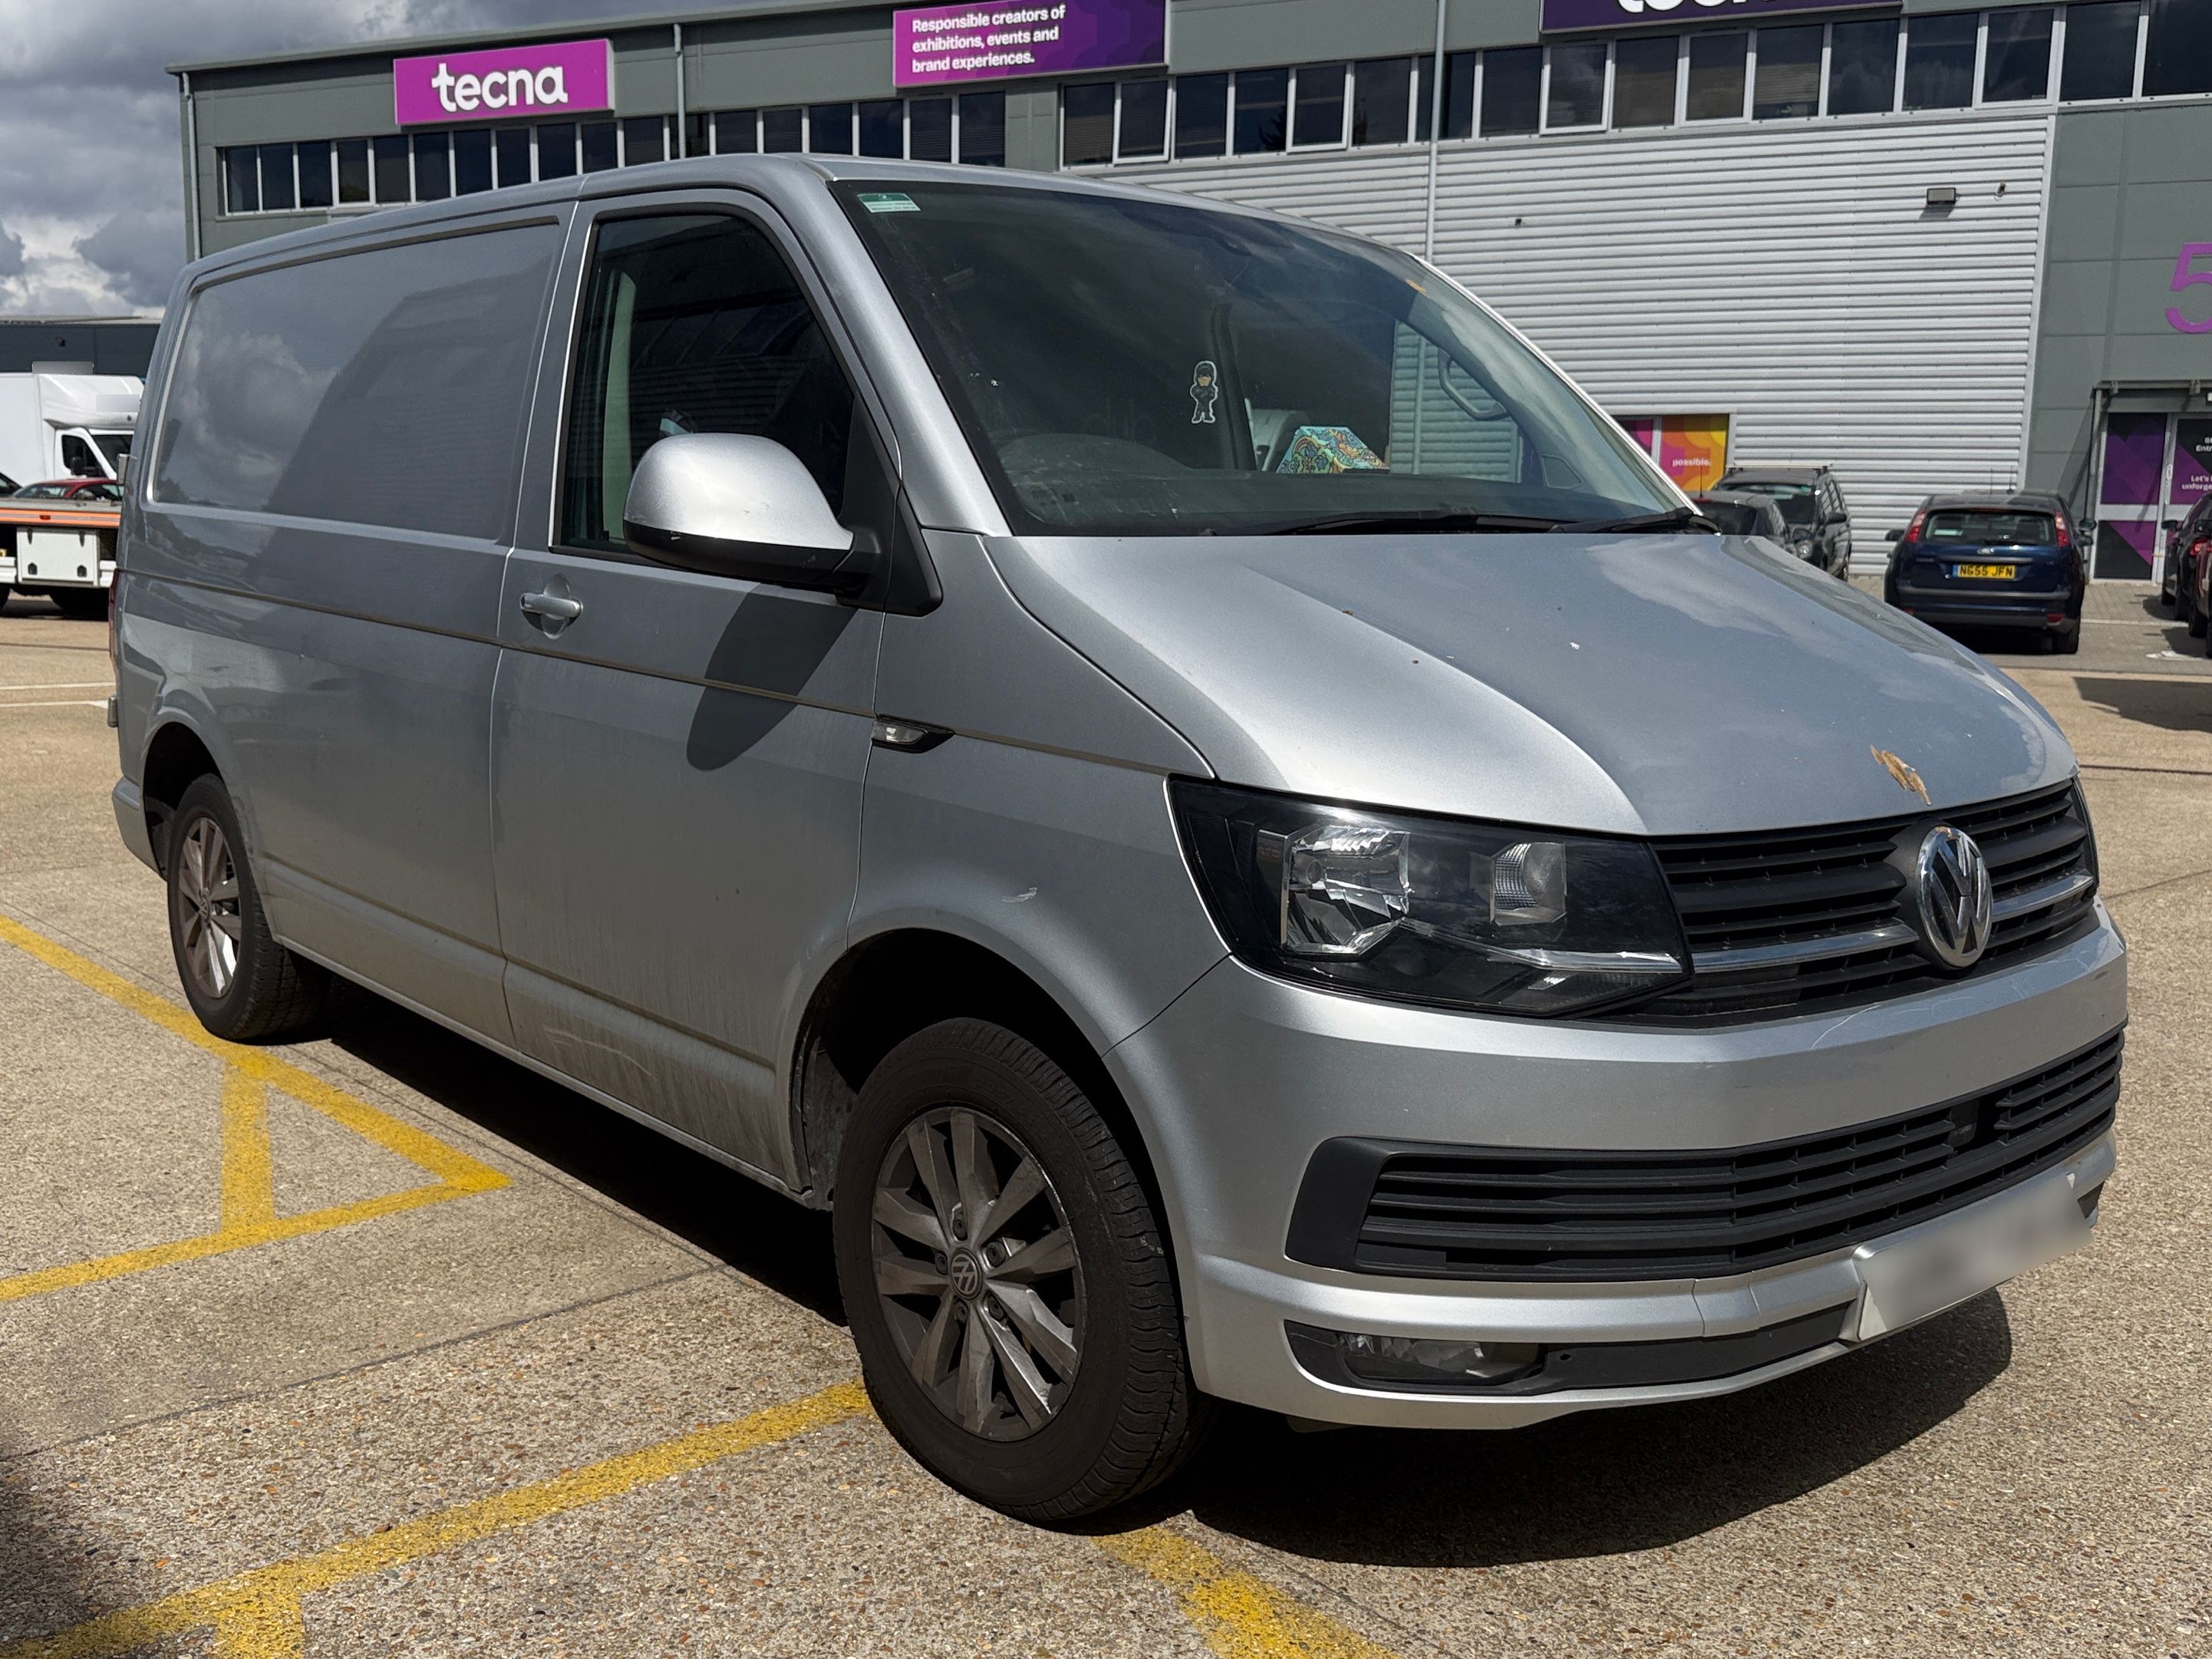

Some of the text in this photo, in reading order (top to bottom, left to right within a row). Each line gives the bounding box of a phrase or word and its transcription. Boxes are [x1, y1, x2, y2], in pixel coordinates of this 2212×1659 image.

[912, 4, 1066, 33] Responsible creators of
[912, 25, 1059, 53] exhibitions, events and
[912, 51, 1036, 73] brand experiences.
[431, 63, 569, 112] tecna
[1673, 458, 1711, 467] possible.
[1960, 565, 2013, 577] NG55 JFN
